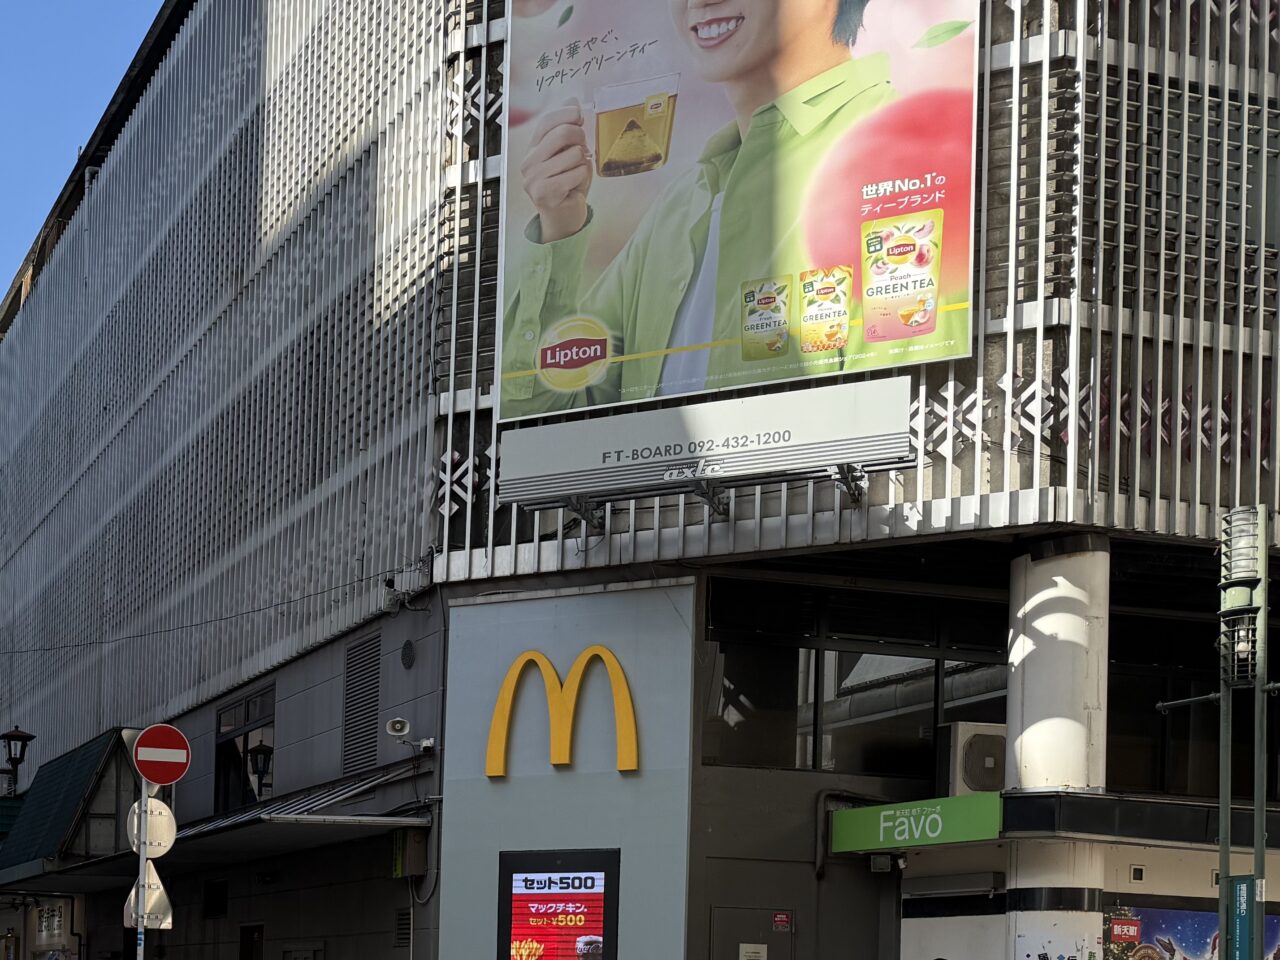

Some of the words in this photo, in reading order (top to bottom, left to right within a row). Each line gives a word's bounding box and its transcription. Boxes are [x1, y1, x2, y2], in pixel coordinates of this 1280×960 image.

[536, 29, 618, 70] 香り華やぐ、
[536, 39, 659, 92] リプトングリーンティー
[861, 190, 945, 216] ティーブランド
[888, 245, 914, 255] Lipton
[866, 282, 909, 297] GREEN
[912, 278, 935, 290] TEA
[744, 322, 771, 331] GREEN
[773, 320, 787, 328] TEA
[803, 312, 831, 322] GREEN
[833, 310, 847, 318] TEA
[546, 344, 601, 365] Lipton
[688, 430, 792, 454] 092-432-1200
[880, 810, 943, 842] Favo
[522, 876, 595, 890] セット500
[529, 917, 551, 925] セット
[552, 915, 585, 926] ¥500
